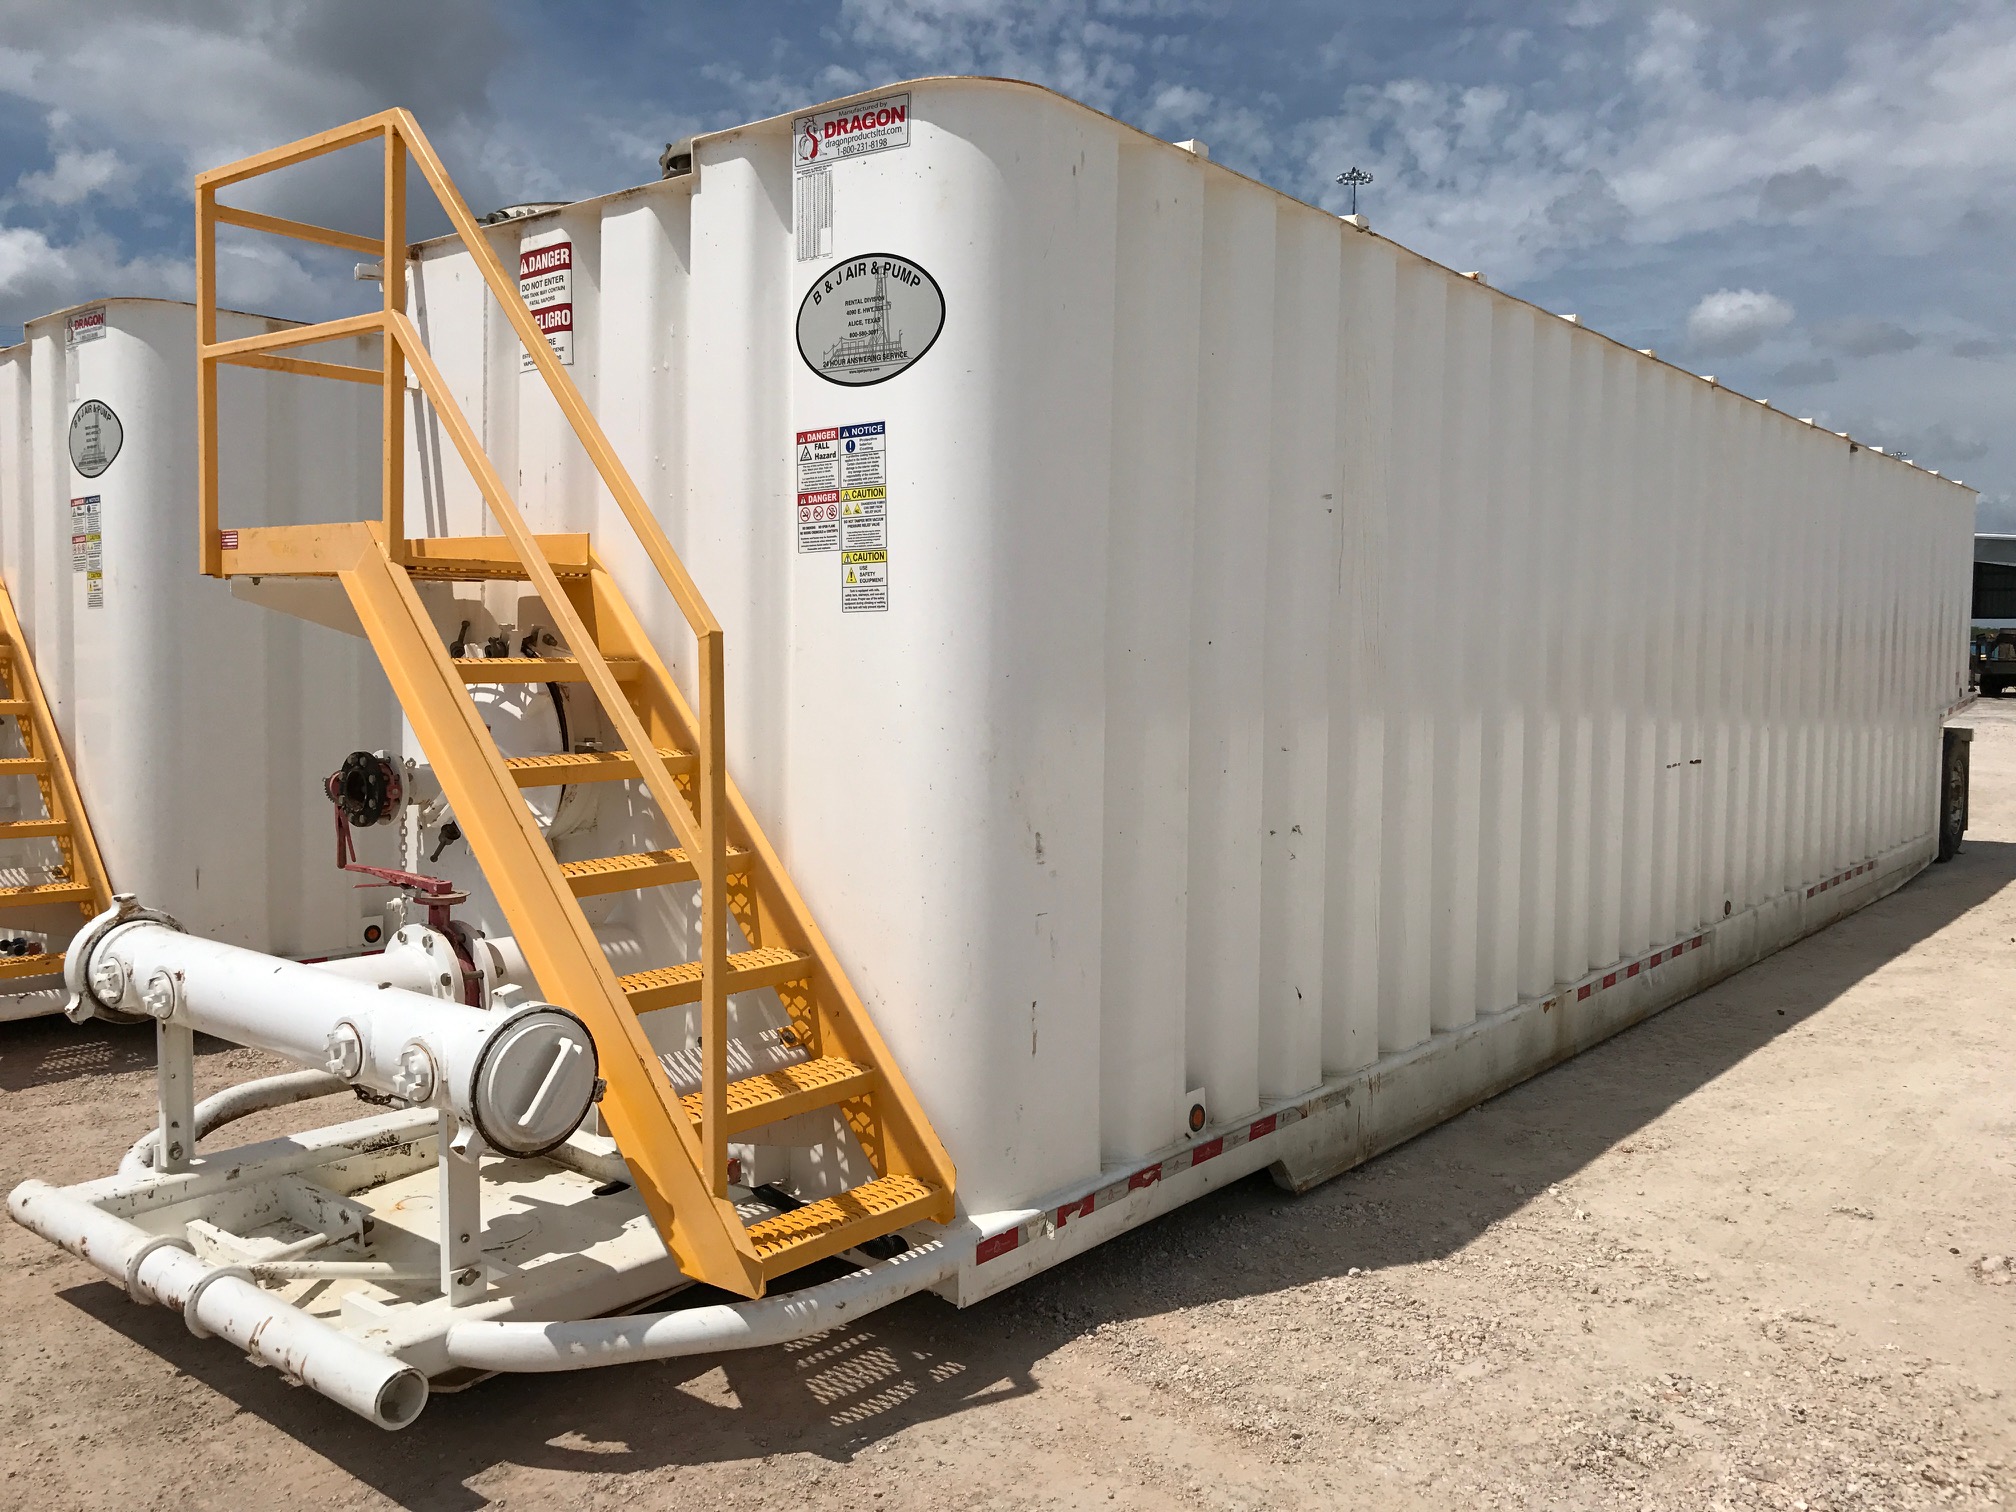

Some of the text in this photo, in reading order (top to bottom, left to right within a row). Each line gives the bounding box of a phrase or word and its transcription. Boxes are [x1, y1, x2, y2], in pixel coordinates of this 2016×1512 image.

[838, 102, 879, 117] Manufactured
[824, 105, 906, 139] DRAGON
[825, 126, 902, 148] dragonproductsltd.com
[837, 138, 888, 156] 1-800-231-8198
[528, 247, 570, 273] DANGER
[522, 275, 564, 292] DO NOT ENTER
[813, 261, 921, 305] B & J AIR & PUMP
[75, 313, 104, 330] DRAGON
[535, 309, 571, 330] ELIGRO
[829, 358, 846, 367] HOUR
[847, 354, 881, 364] ANSWERING
[882, 351, 908, 360] SERVICE
[807, 430, 836, 442] DANGER
[851, 424, 883, 436] NOTICE
[814, 442, 830, 450] FALL
[814, 451, 837, 460] Hazard
[808, 493, 837, 503] DANGER
[851, 488, 884, 499] CAUTION
[852, 551, 885, 562] CAUTION
